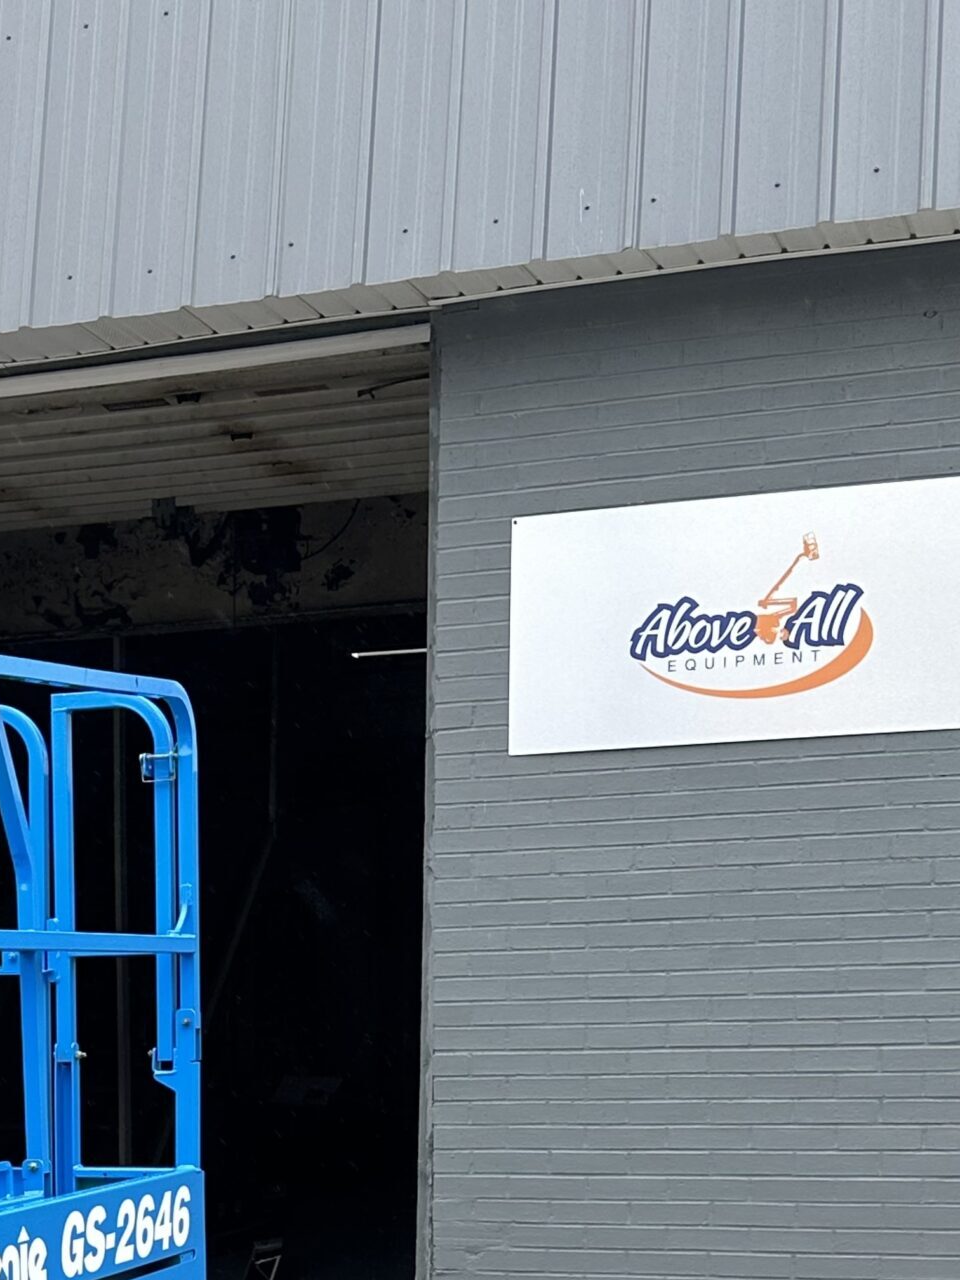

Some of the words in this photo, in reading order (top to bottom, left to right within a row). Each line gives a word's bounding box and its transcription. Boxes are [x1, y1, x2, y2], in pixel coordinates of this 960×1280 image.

[631, 597, 757, 661] Above
[783, 583, 864, 649] All
[668, 651, 820, 673] EQUIPMENT
[61, 1185, 191, 1277] GS-2646
